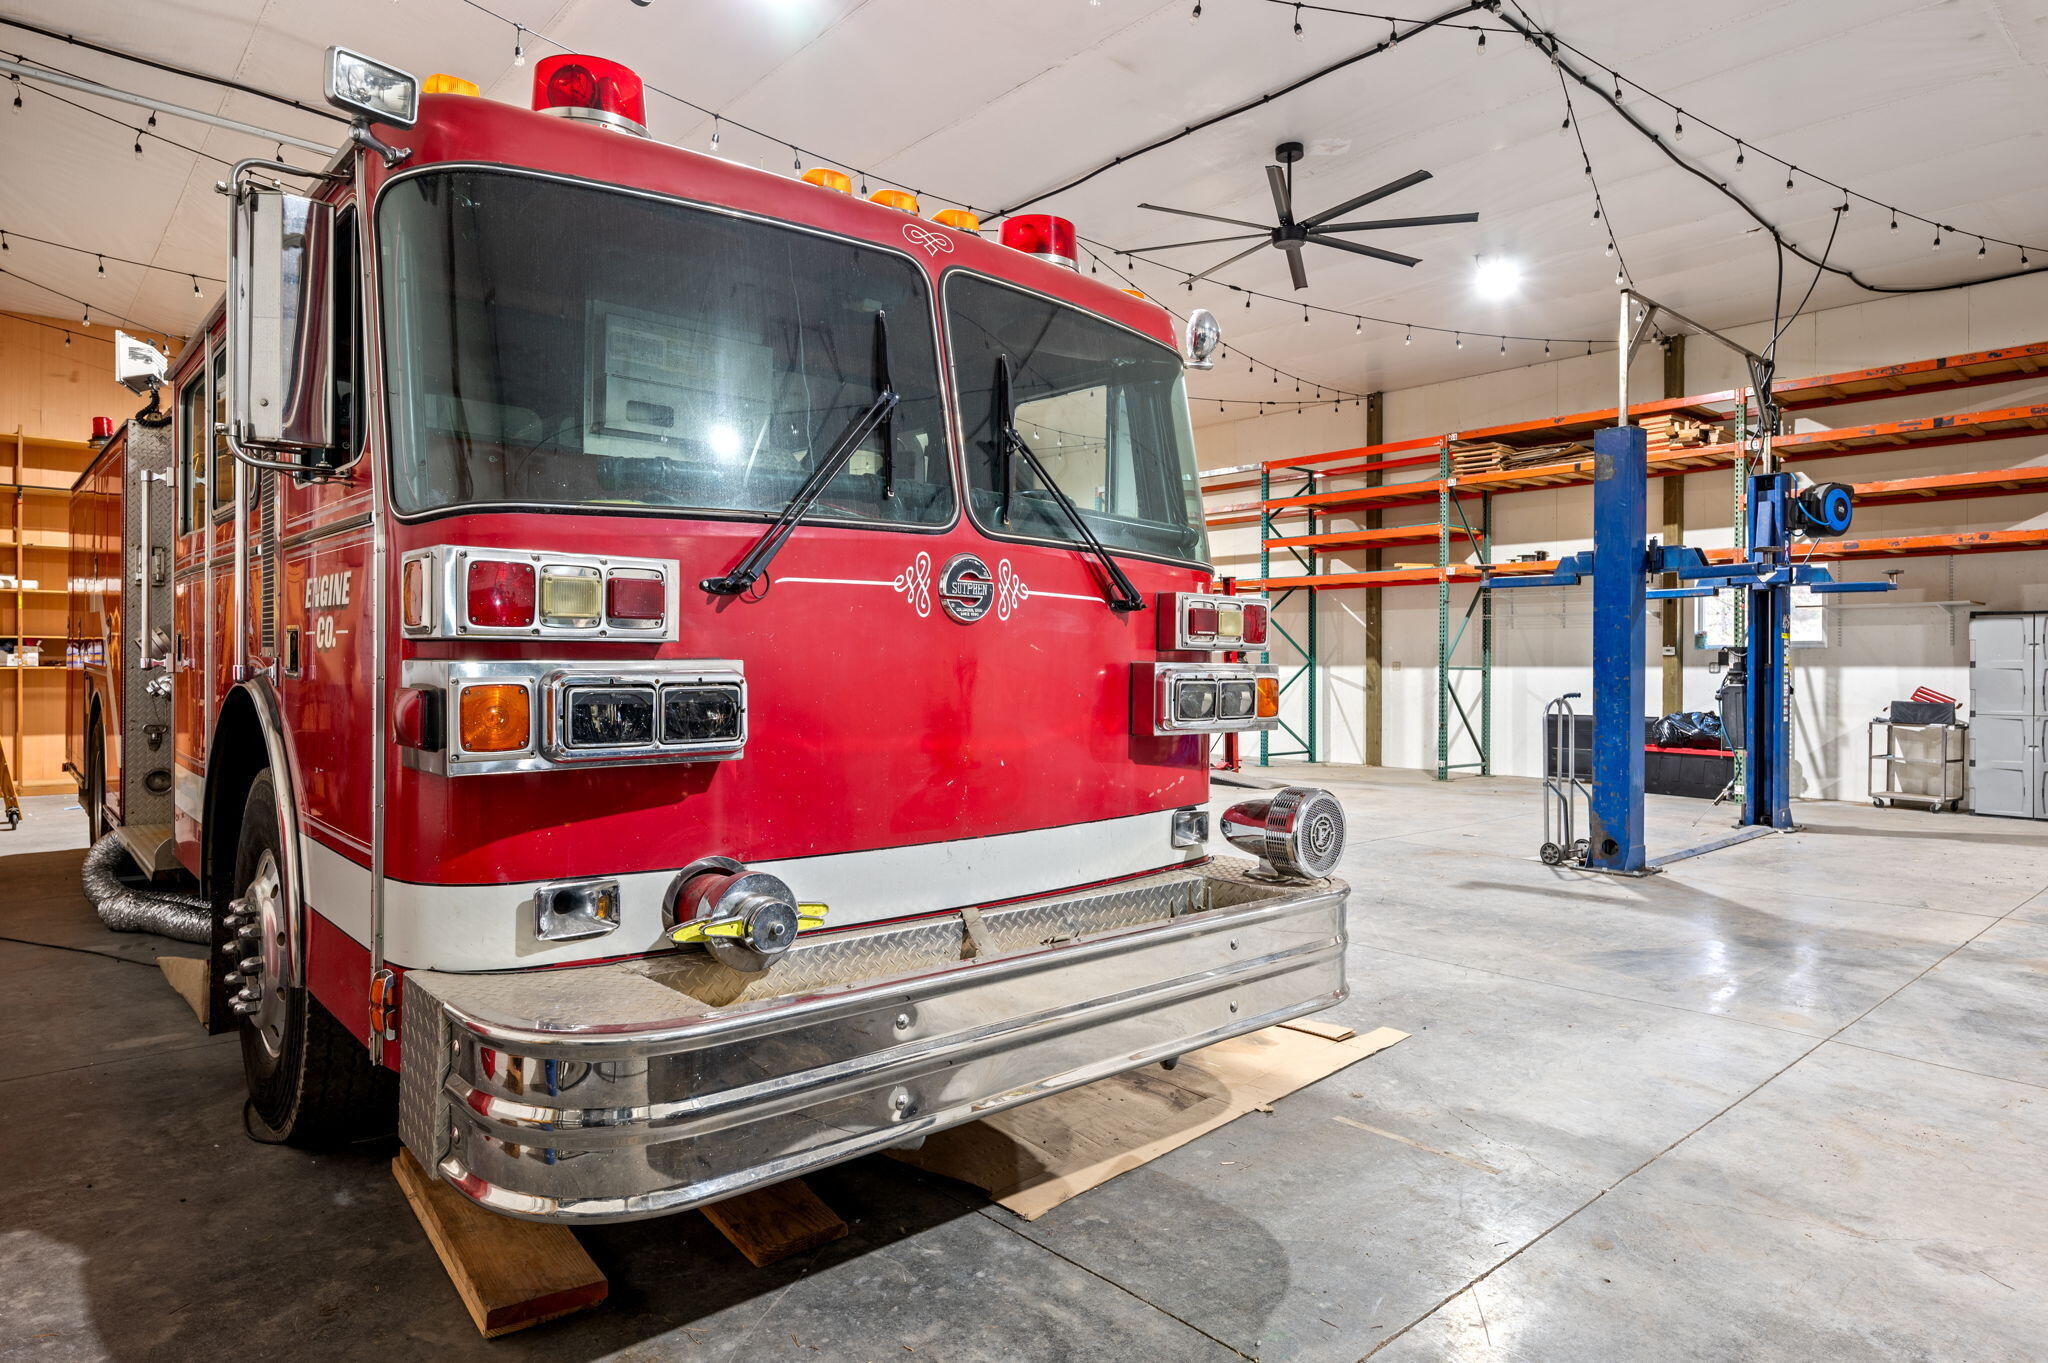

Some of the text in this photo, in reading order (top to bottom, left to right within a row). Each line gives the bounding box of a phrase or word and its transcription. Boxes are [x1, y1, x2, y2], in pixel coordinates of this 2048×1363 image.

[305, 570, 352, 609] ENGINE
[951, 582, 988, 596] SUTPHEN
[316, 615, 336, 648] CO.
